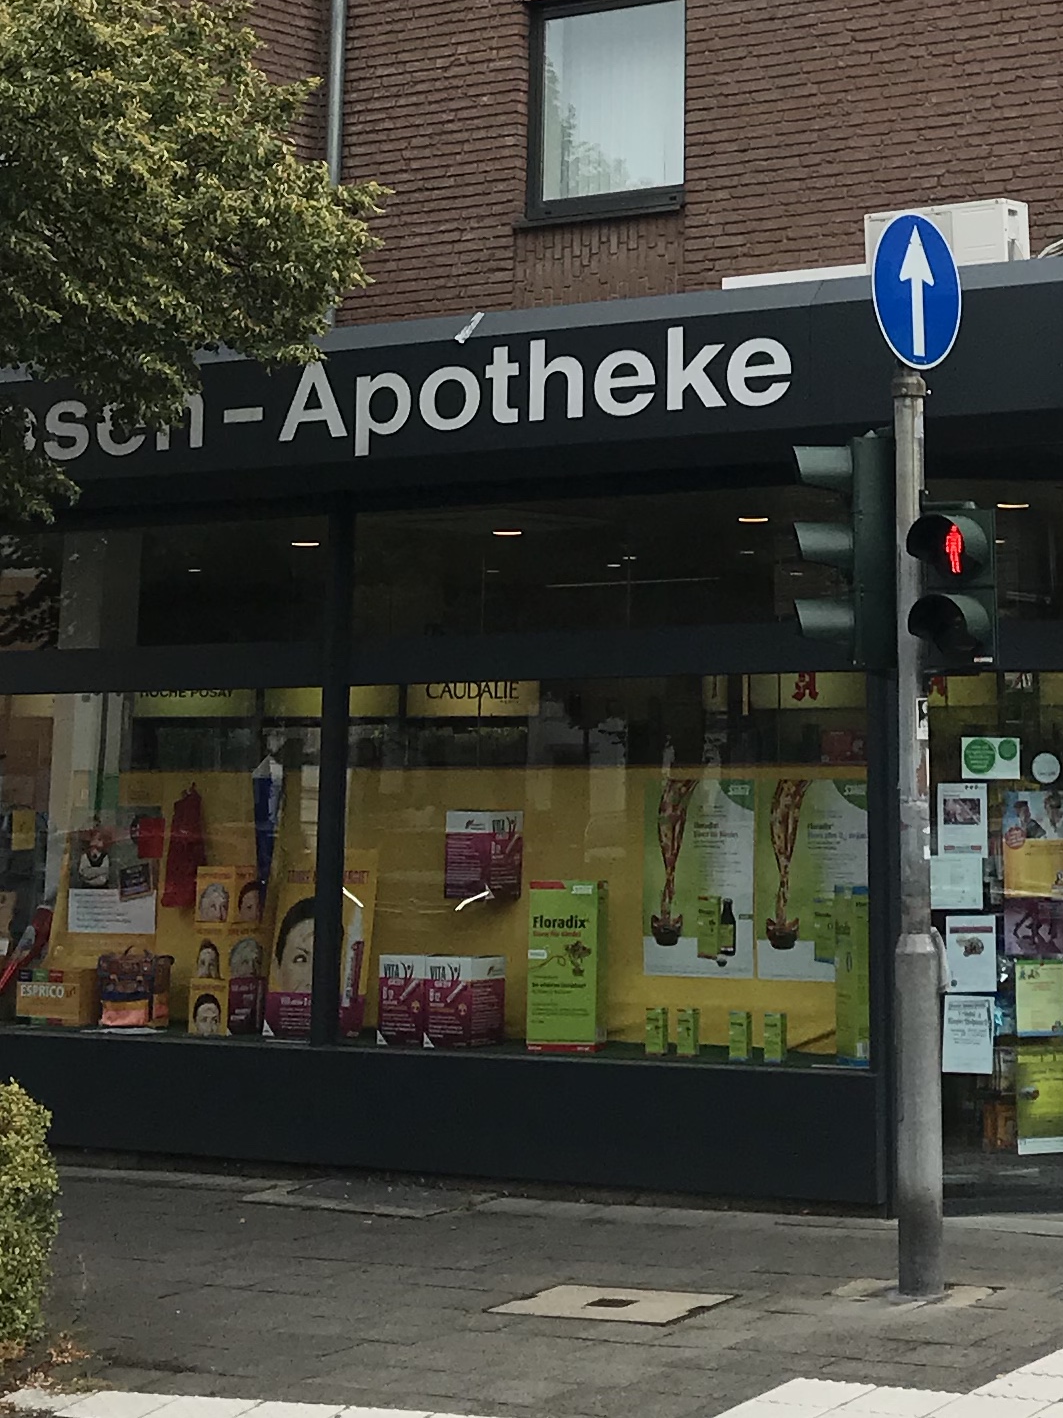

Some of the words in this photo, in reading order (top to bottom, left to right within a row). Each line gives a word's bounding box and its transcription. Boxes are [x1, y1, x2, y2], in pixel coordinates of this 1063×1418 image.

[426, 681, 519, 699] CAUDALIE
[533, 915, 586, 929] Floradix
[20, 984, 65, 998] ESPRICO
